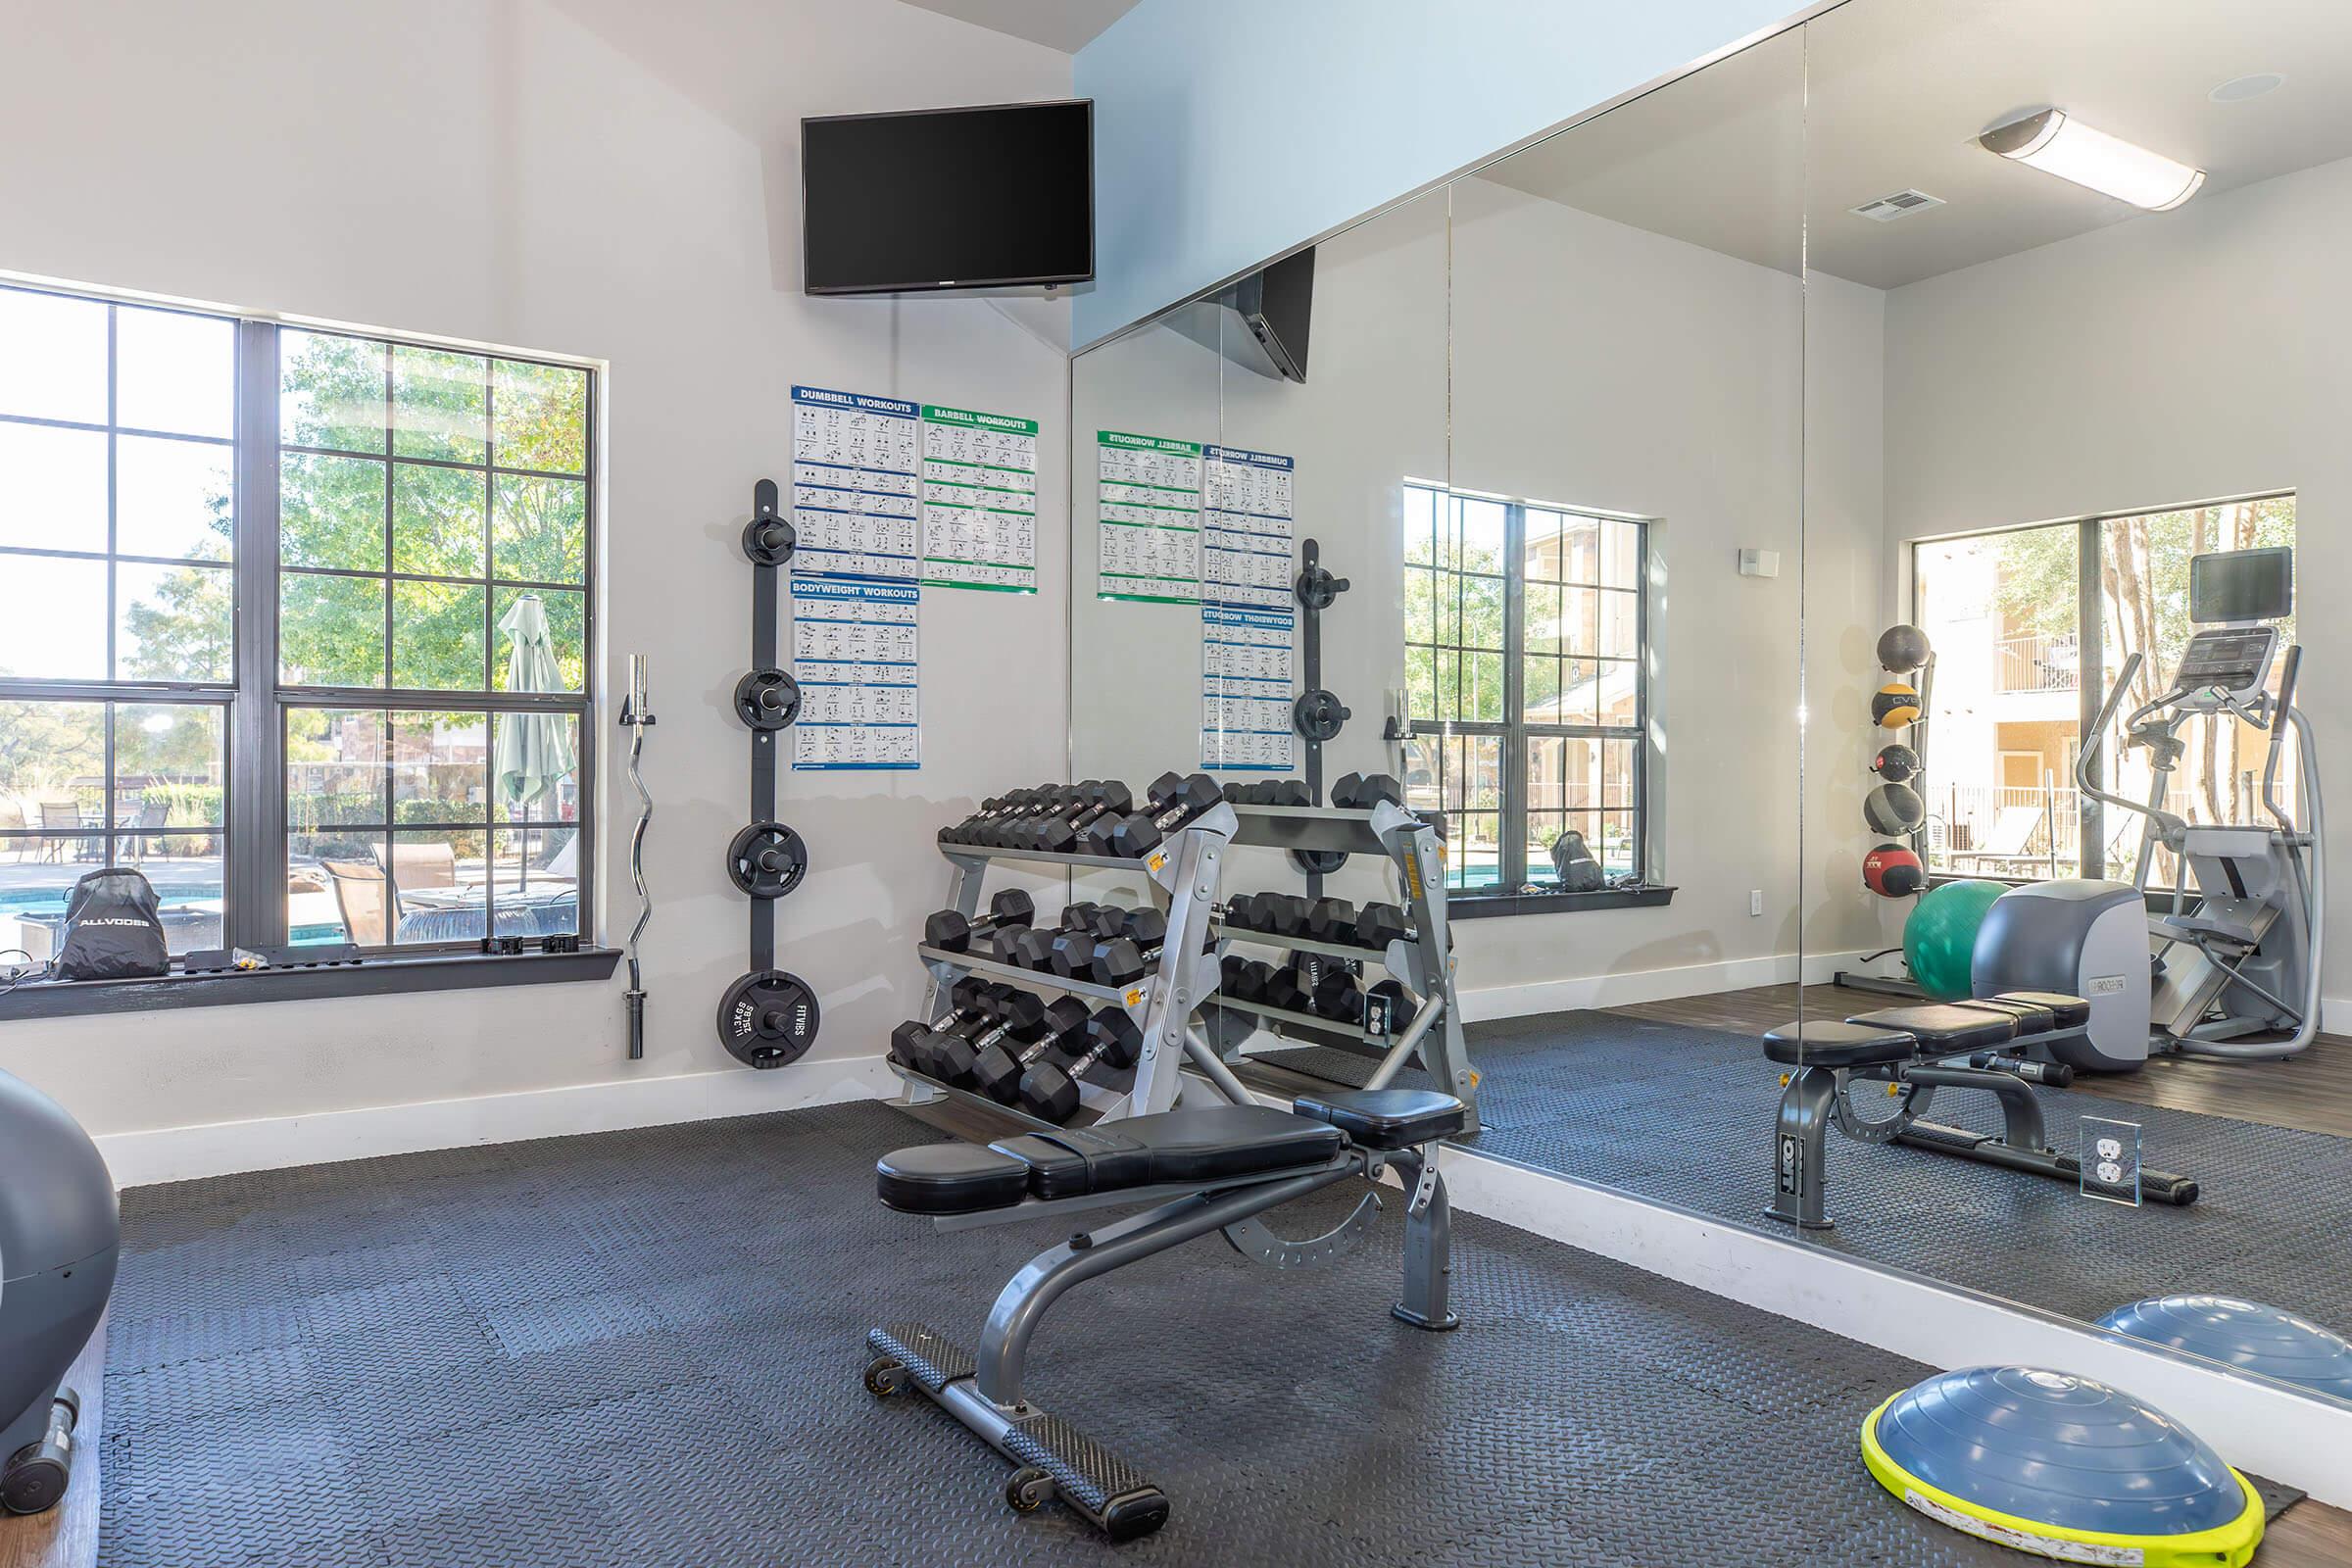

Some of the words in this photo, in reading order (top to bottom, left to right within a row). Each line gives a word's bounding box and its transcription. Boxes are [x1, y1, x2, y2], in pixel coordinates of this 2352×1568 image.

[801, 389, 854, 405] DUMBBELL
[857, 397, 911, 413] WORKOUTS
[934, 409, 974, 422] BARBELL
[976, 415, 1027, 429] WORKOUTS
[792, 583, 862, 596] BODYWEIGHT
[862, 588, 918, 599] WORKOUTS
[742, 1004, 754, 1034] 25LBS
[795, 1004, 808, 1036] FITVIBS
